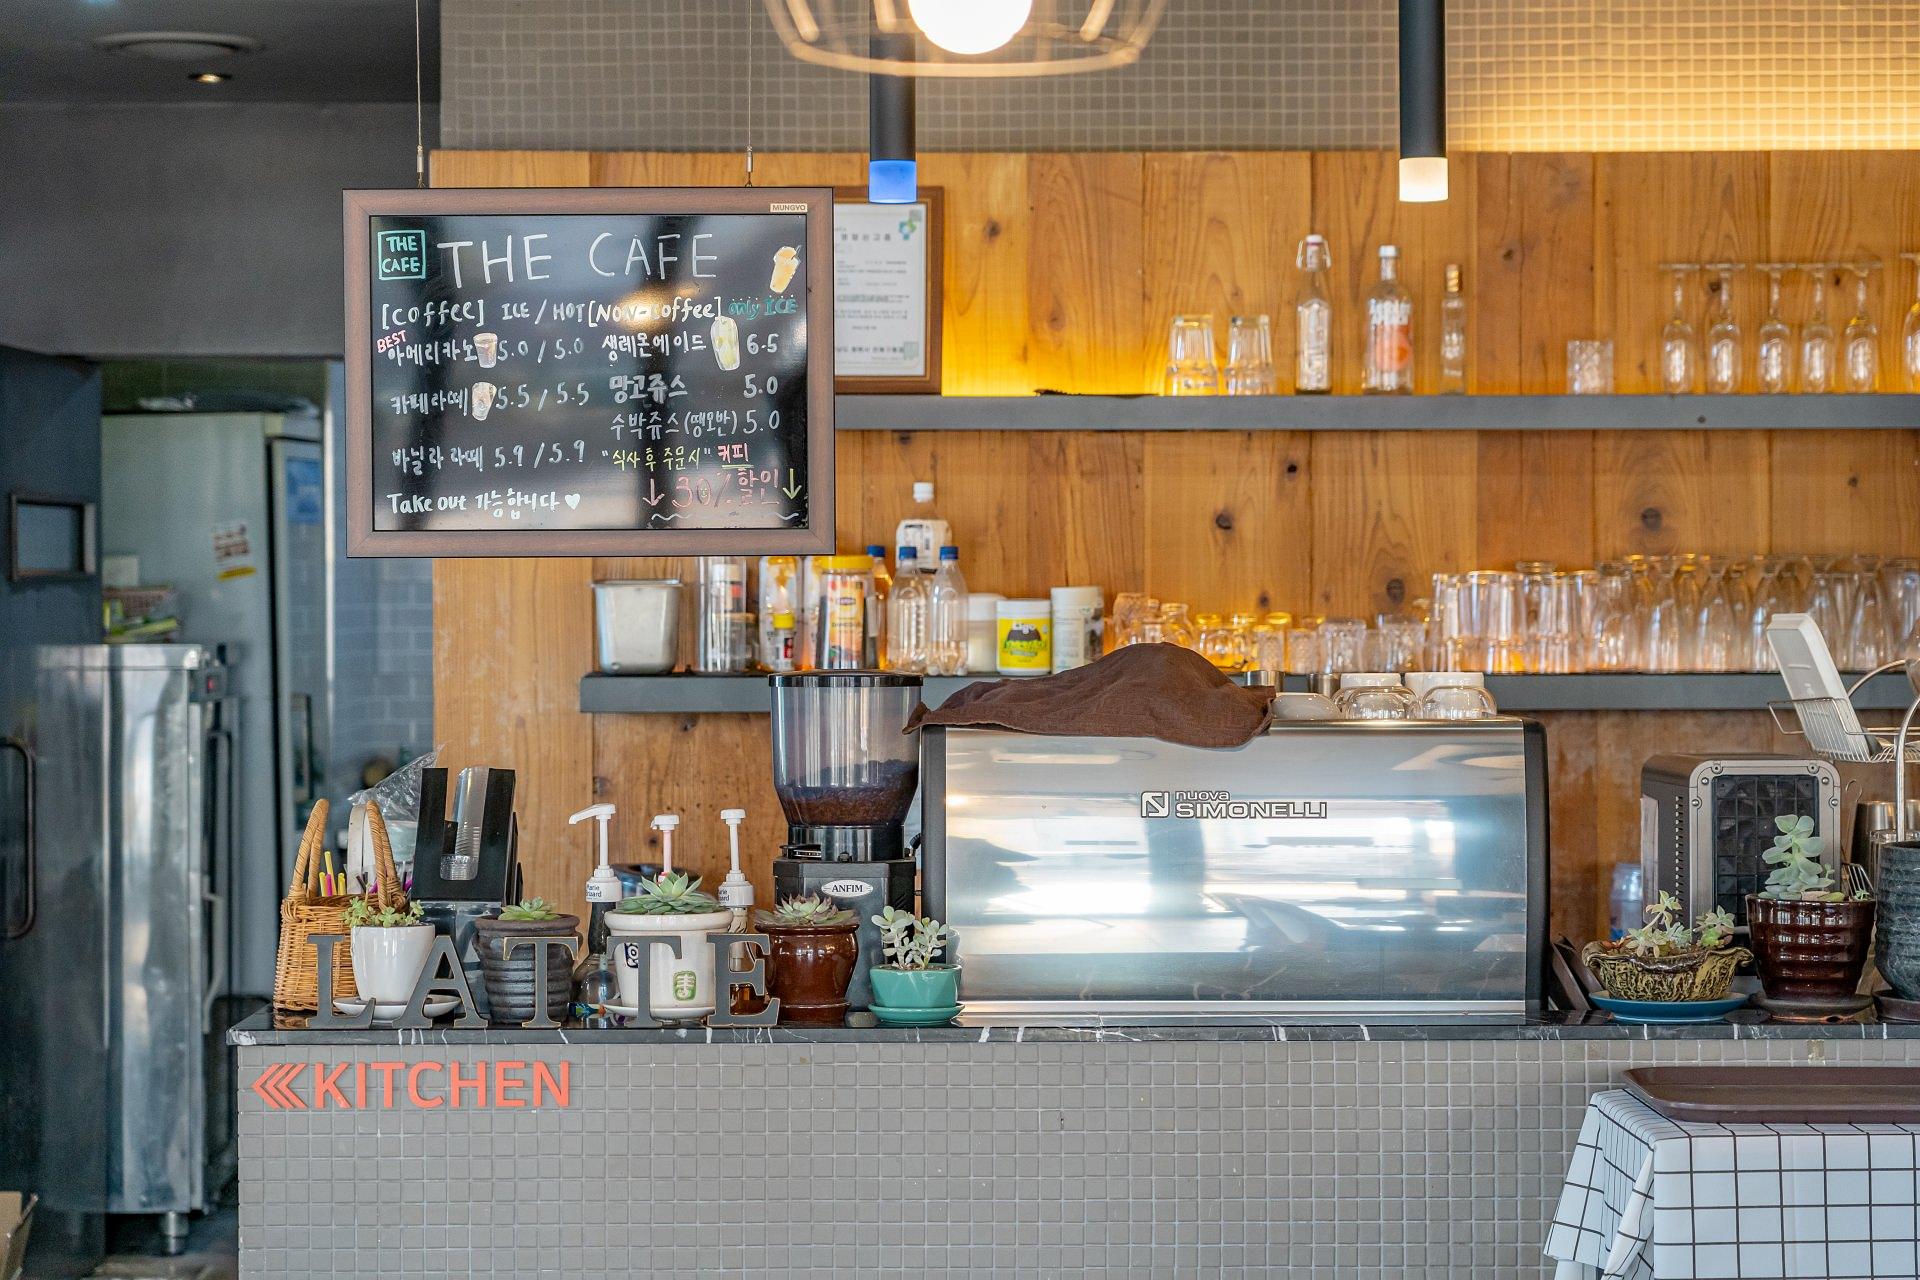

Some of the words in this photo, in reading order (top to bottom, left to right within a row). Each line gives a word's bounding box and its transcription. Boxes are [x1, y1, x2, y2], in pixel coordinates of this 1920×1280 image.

[385, 235, 418, 252] THE
[382, 256, 421, 273] CAFE
[436, 233, 552, 289] THE
[589, 232, 718, 280] CAFE
[502, 302, 530, 321] ICE
[553, 301, 586, 323] HOT
[728, 300, 760, 320] only
[764, 298, 799, 316] ICE
[376, 329, 407, 354] BEST
[387, 338, 478, 366] 아메리카노
[498, 340, 529, 361] 5.0
[555, 337, 584, 360] 5.0
[601, 330, 707, 363] 생레몬에이드
[746, 333, 780, 355] 6.5
[495, 383, 531, 410] 5.5
[556, 381, 590, 406] 5.5
[609, 373, 688, 405] 망고쥬스
[743, 373, 779, 399] 5.0
[742, 409, 781, 435] 5.0
[391, 445, 444, 476] 바닐라
[450, 445, 484, 472] 라떼
[494, 443, 524, 469] 5.9
[549, 439, 585, 464] 5.9
[717, 442, 749, 463] 커피
[671, 472, 732, 509] 30%
[737, 467, 780, 506] 할인
[386, 492, 434, 514] Take
[437, 493, 467, 511] out
[474, 487, 560, 520] 가능합니다
[1175, 790, 1230, 801] nuova
[1175, 801, 1328, 820] SIMONELLI
[831, 884, 863, 893] ANFIM
[305, 934, 781, 1029] LATTE
[315, 1060, 570, 1109] KITCHEN
